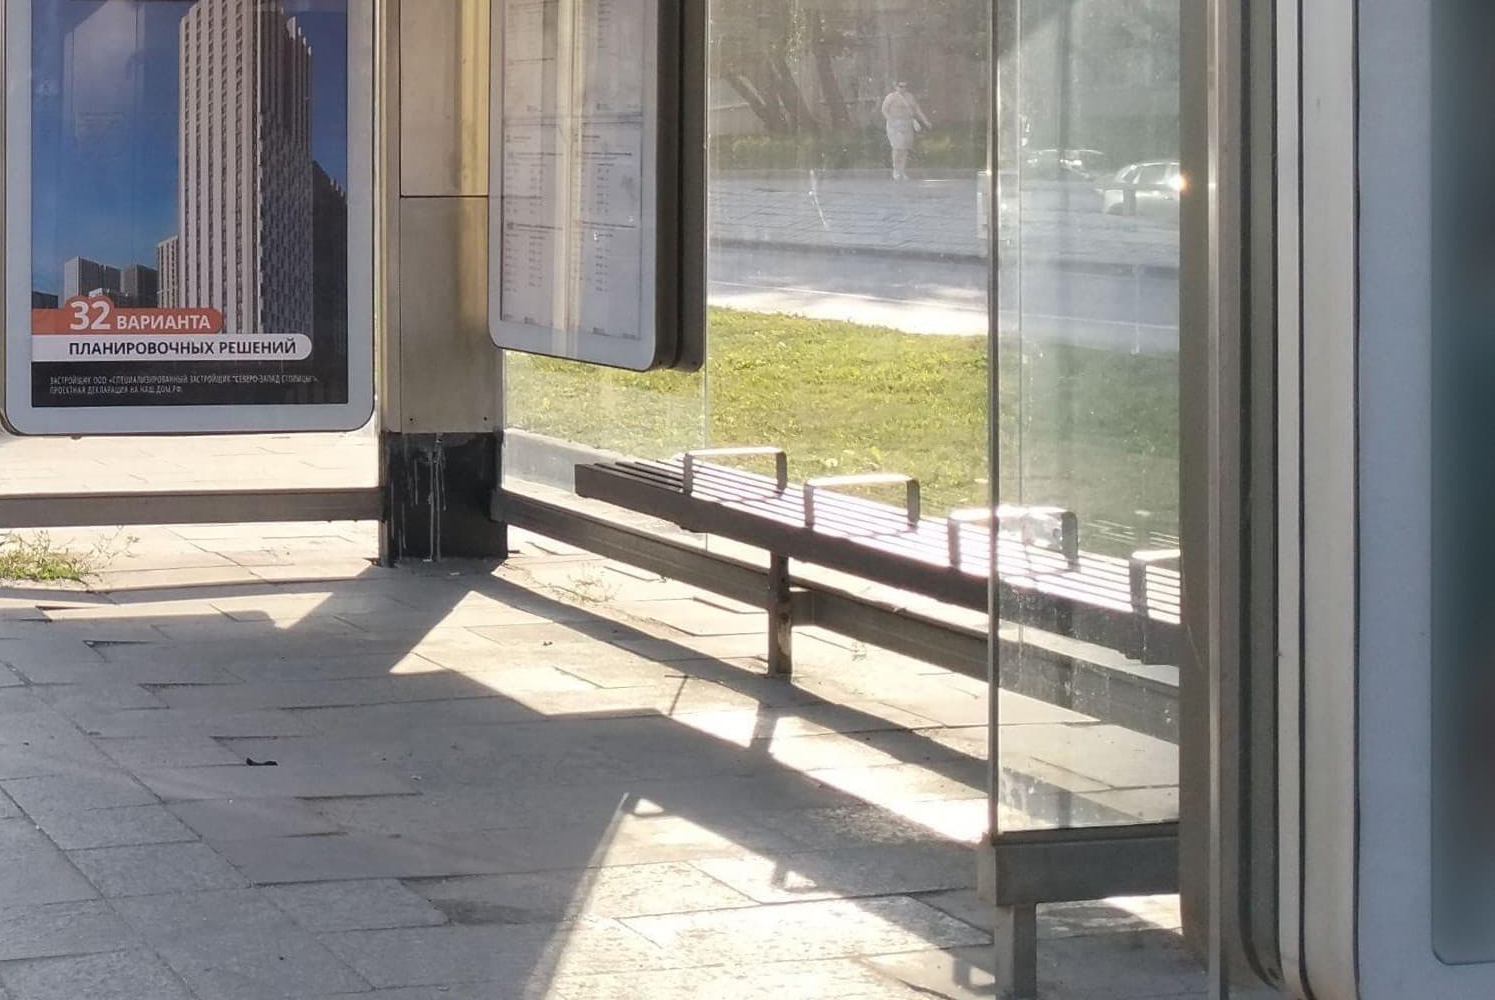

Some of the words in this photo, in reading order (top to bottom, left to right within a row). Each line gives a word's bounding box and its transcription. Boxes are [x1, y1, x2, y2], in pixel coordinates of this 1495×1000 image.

[69, 300, 111, 331] 32
[116, 314, 210, 330] ВАРИАНТА
[69, 341, 215, 356] ПЛАНИРОВОЧНЫХ
[219, 337, 296, 355] РЕШЕНИЙ
